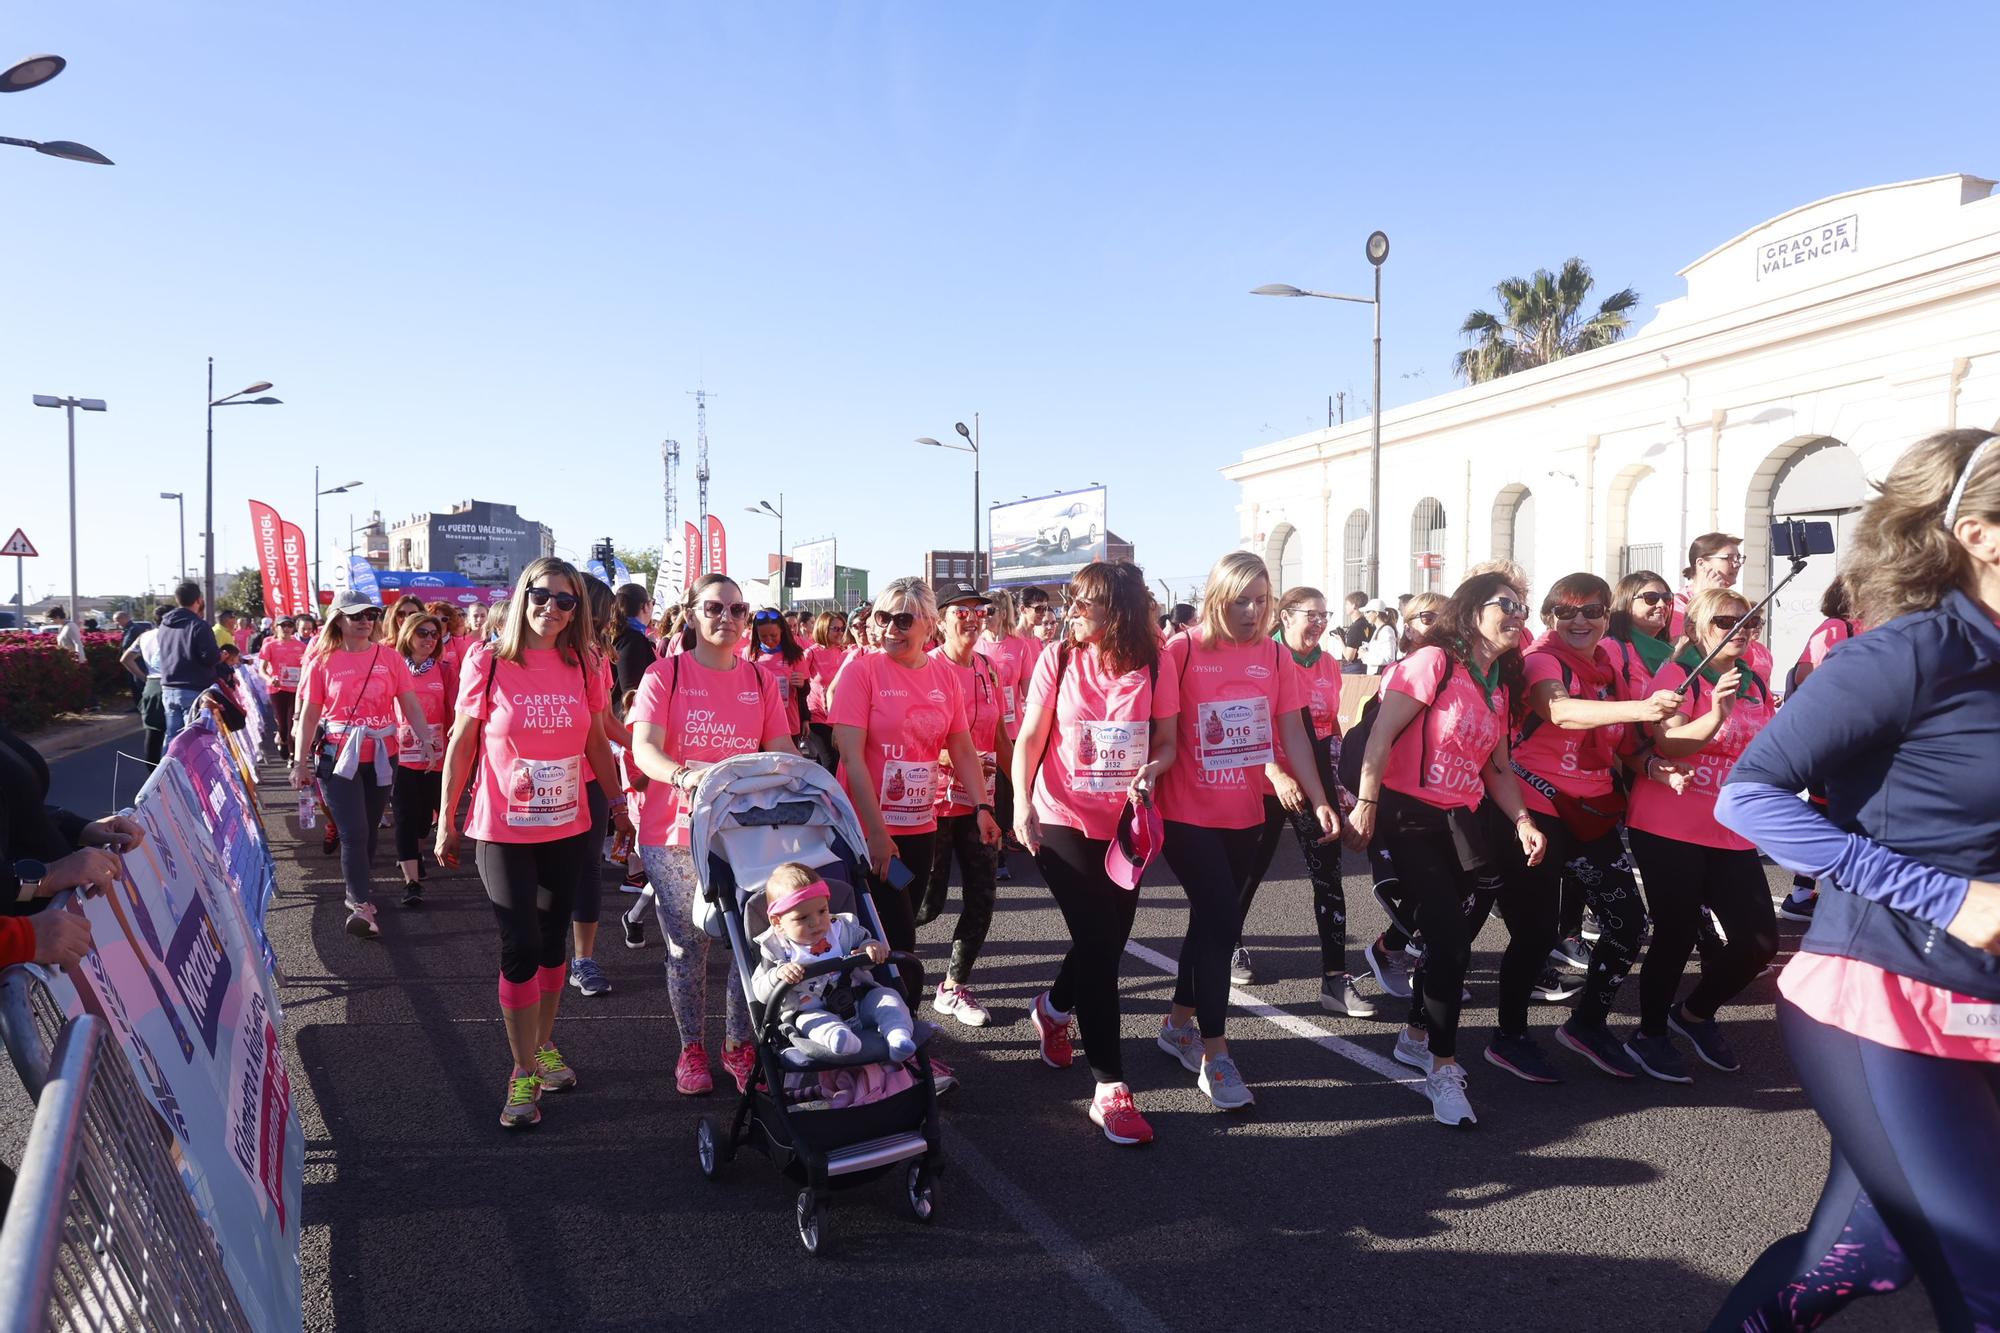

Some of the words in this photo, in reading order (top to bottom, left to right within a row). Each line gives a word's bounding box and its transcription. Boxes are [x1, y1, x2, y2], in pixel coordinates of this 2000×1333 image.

[1766, 235, 1813, 260] GRAO
[1822, 222, 1848, 242] DE
[1762, 237, 1850, 275] VALENCIA
[447, 524, 477, 533] PUERTO
[1192, 665, 1223, 673] OYSHO
[512, 693, 579, 706] CARRERA
[879, 689, 908, 697] OYSHO
[527, 706, 546, 717] DE
[550, 705, 569, 716] LA
[686, 709, 716, 722] HOY
[523, 716, 573, 729] MUJER
[684, 721, 736, 735] GANAN
[1226, 725, 1251, 738] 016
[683, 735, 708, 747] LAS
[710, 735, 758, 750] CHICAS
[1231, 737, 1247, 745] 3135
[881, 743, 904, 760] TU
[1099, 749, 1126, 760] 016
[1434, 749, 1452, 764] TU
[1104, 761, 1121, 769] 3132
[1209, 758, 1233, 766] OYSHO
[1700, 753, 1719, 766] TU
[1197, 767, 1247, 784] SUMA
[537, 785, 562, 797] 016
[906, 787, 927, 797] 016
[177, 913, 223, 1029] Norauto
[1966, 1013, 2000, 1026] OYS
[234, 1071, 258, 1185] Kilómetro
